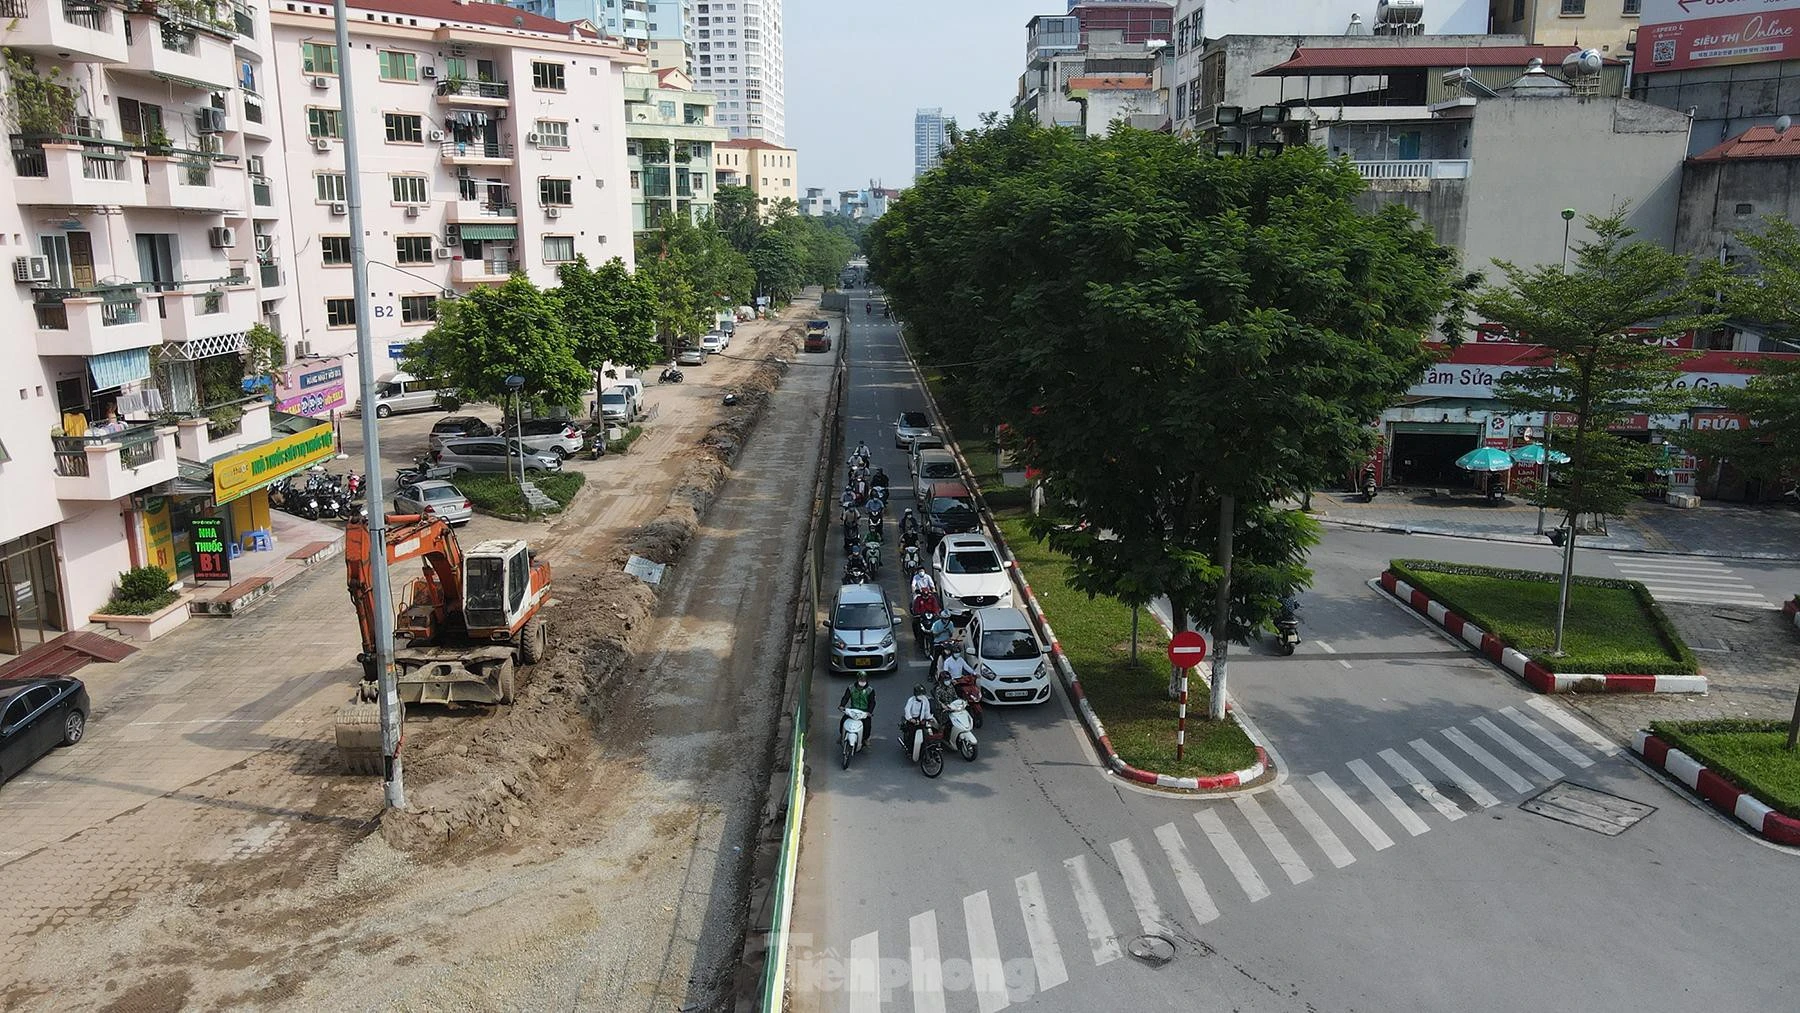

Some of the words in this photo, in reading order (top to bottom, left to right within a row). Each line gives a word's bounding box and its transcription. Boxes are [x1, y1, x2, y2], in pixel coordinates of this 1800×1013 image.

[1693, 34, 1718, 47] SIÊU
[1743, 15, 1793, 42] Online
[374, 306, 394, 318] B2
[1420, 367, 1454, 385] âm
[1459, 367, 1493, 386] Sửa
[1697, 414, 1741, 431] RỬA
[195, 538, 223, 552] THUỐC
[199, 553, 222, 571] B1
